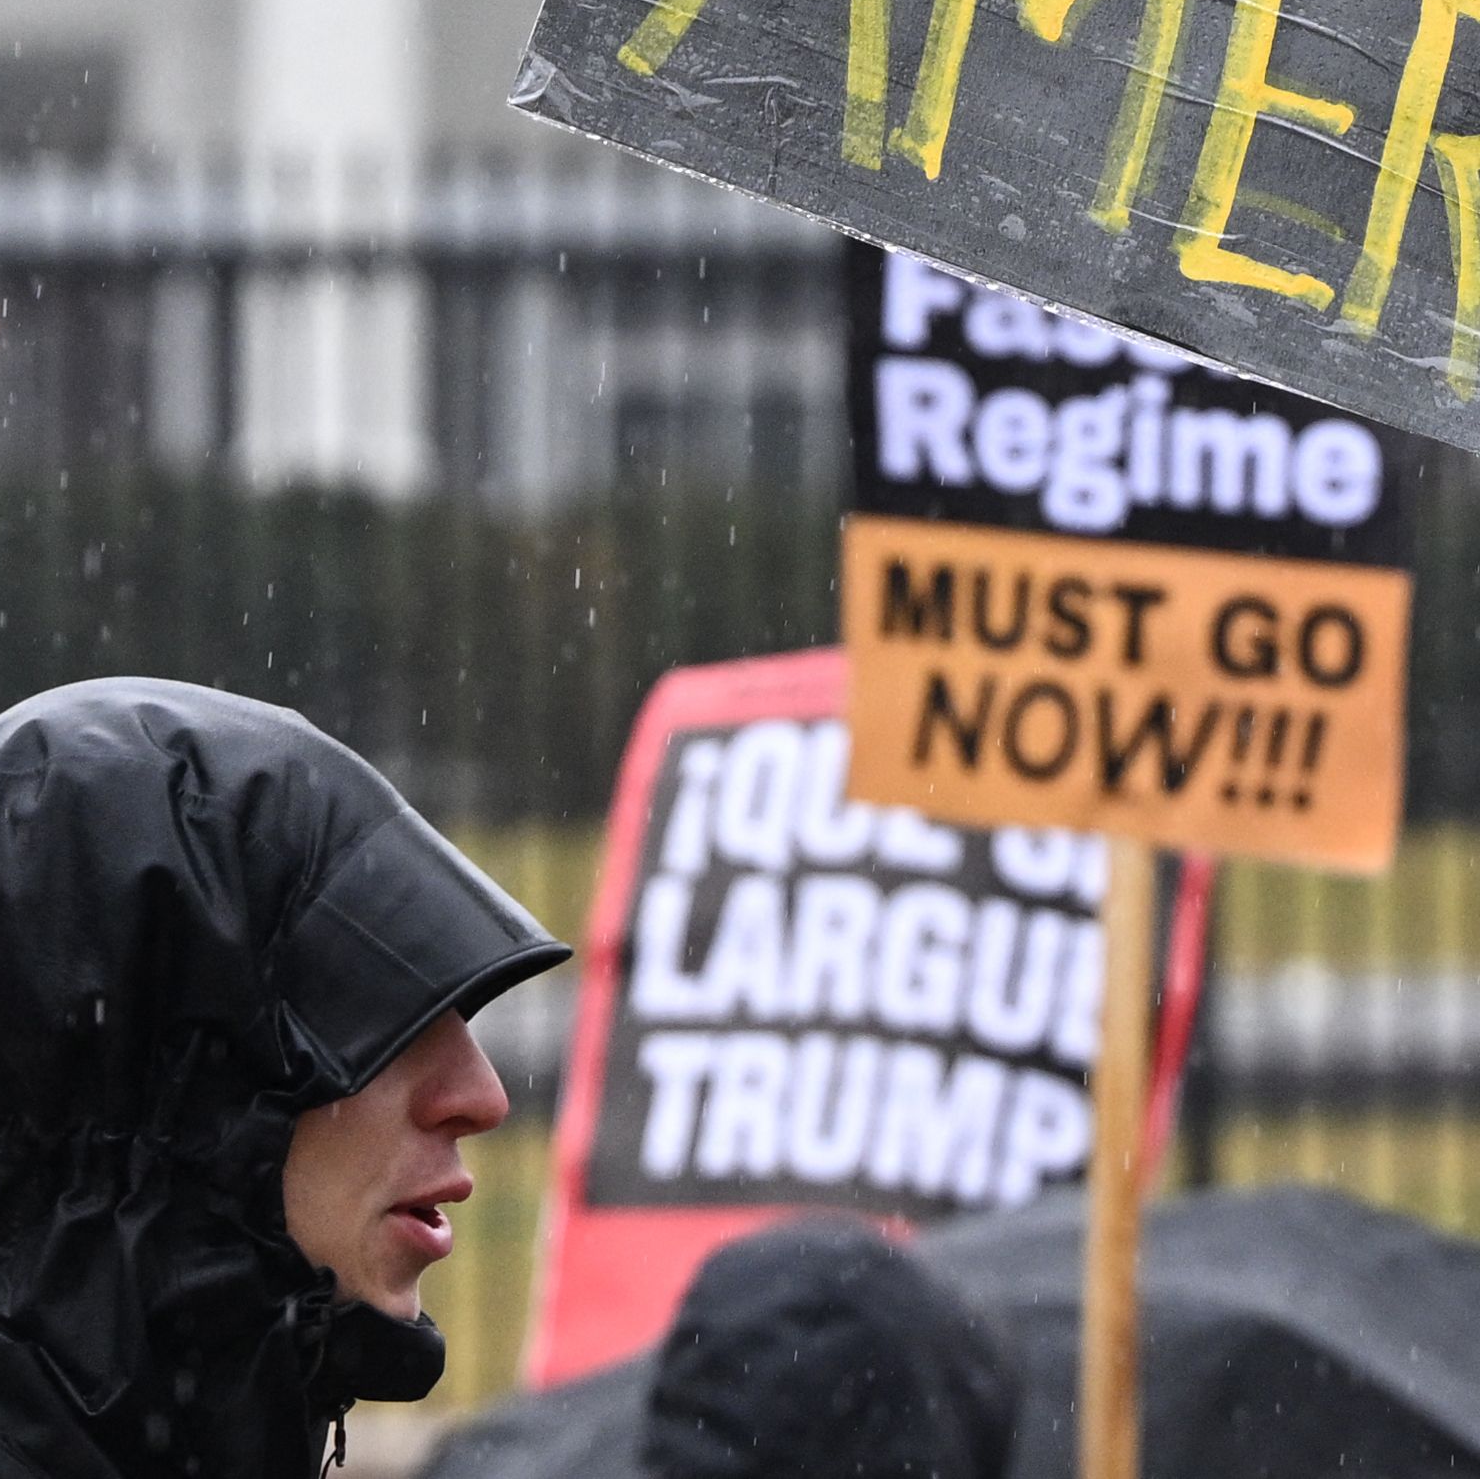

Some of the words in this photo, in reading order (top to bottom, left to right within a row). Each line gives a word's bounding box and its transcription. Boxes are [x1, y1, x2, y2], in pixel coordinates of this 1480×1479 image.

[874, 357, 1382, 532] Regime
[878, 557, 1168, 667] MUST
[1210, 594, 1366, 689] GO
[908, 668, 1332, 810] NOW!!!
[638, 1030, 1096, 1209] TRUMP
